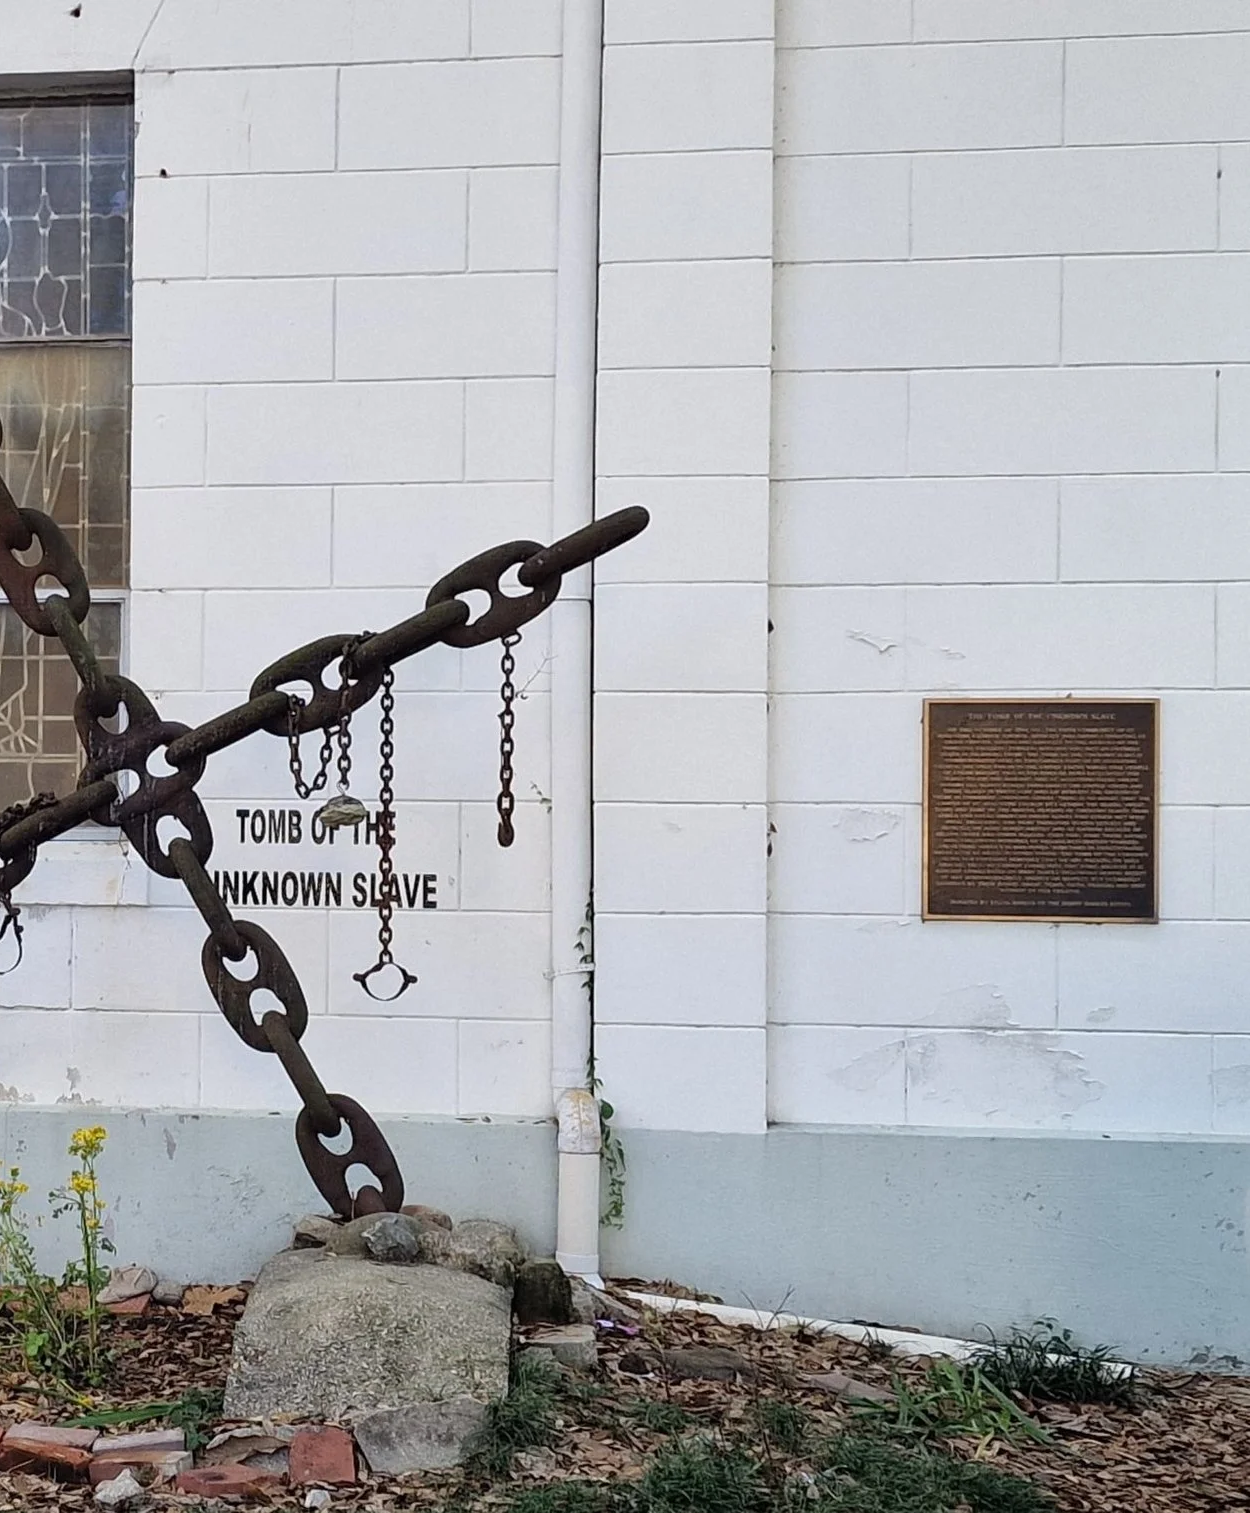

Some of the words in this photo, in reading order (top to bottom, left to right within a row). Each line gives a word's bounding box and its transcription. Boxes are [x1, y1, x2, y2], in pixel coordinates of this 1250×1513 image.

[236, 809, 301, 844] TOMB
[213, 870, 342, 907] NKNOWN
[352, 872, 437, 909] SLAVE
